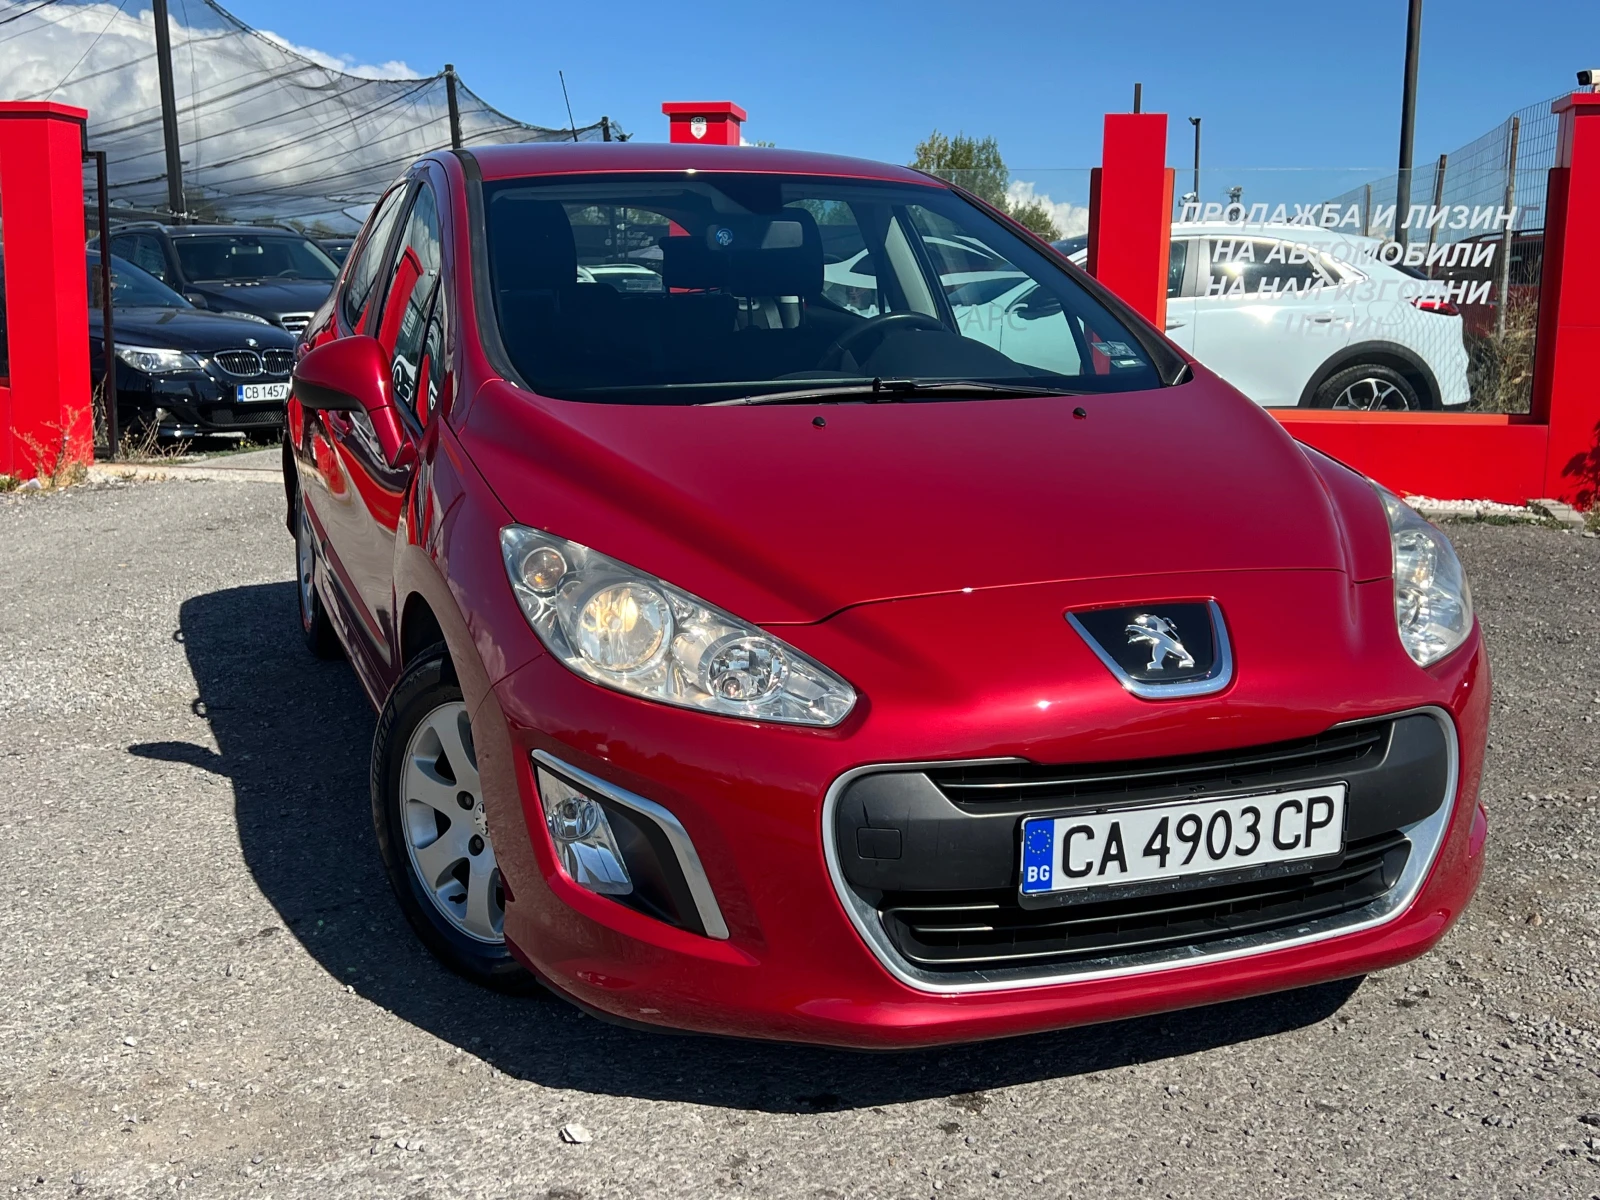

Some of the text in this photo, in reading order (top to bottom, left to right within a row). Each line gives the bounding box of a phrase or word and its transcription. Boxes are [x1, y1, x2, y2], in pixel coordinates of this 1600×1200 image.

[1179, 202, 1540, 231] ПРОДАЖБА И ЛИЗИНГ
[1212, 239, 1497, 267] НА АВТОМОБИЛИ
[1204, 271, 1493, 309] НА НАЙ ИЗГОДНИ
[245, 386, 260, 399] CB
[262, 384, 285, 398] 1457
[1062, 795, 1335, 879] CA 4903 CP
[1027, 865, 1051, 883] BG
